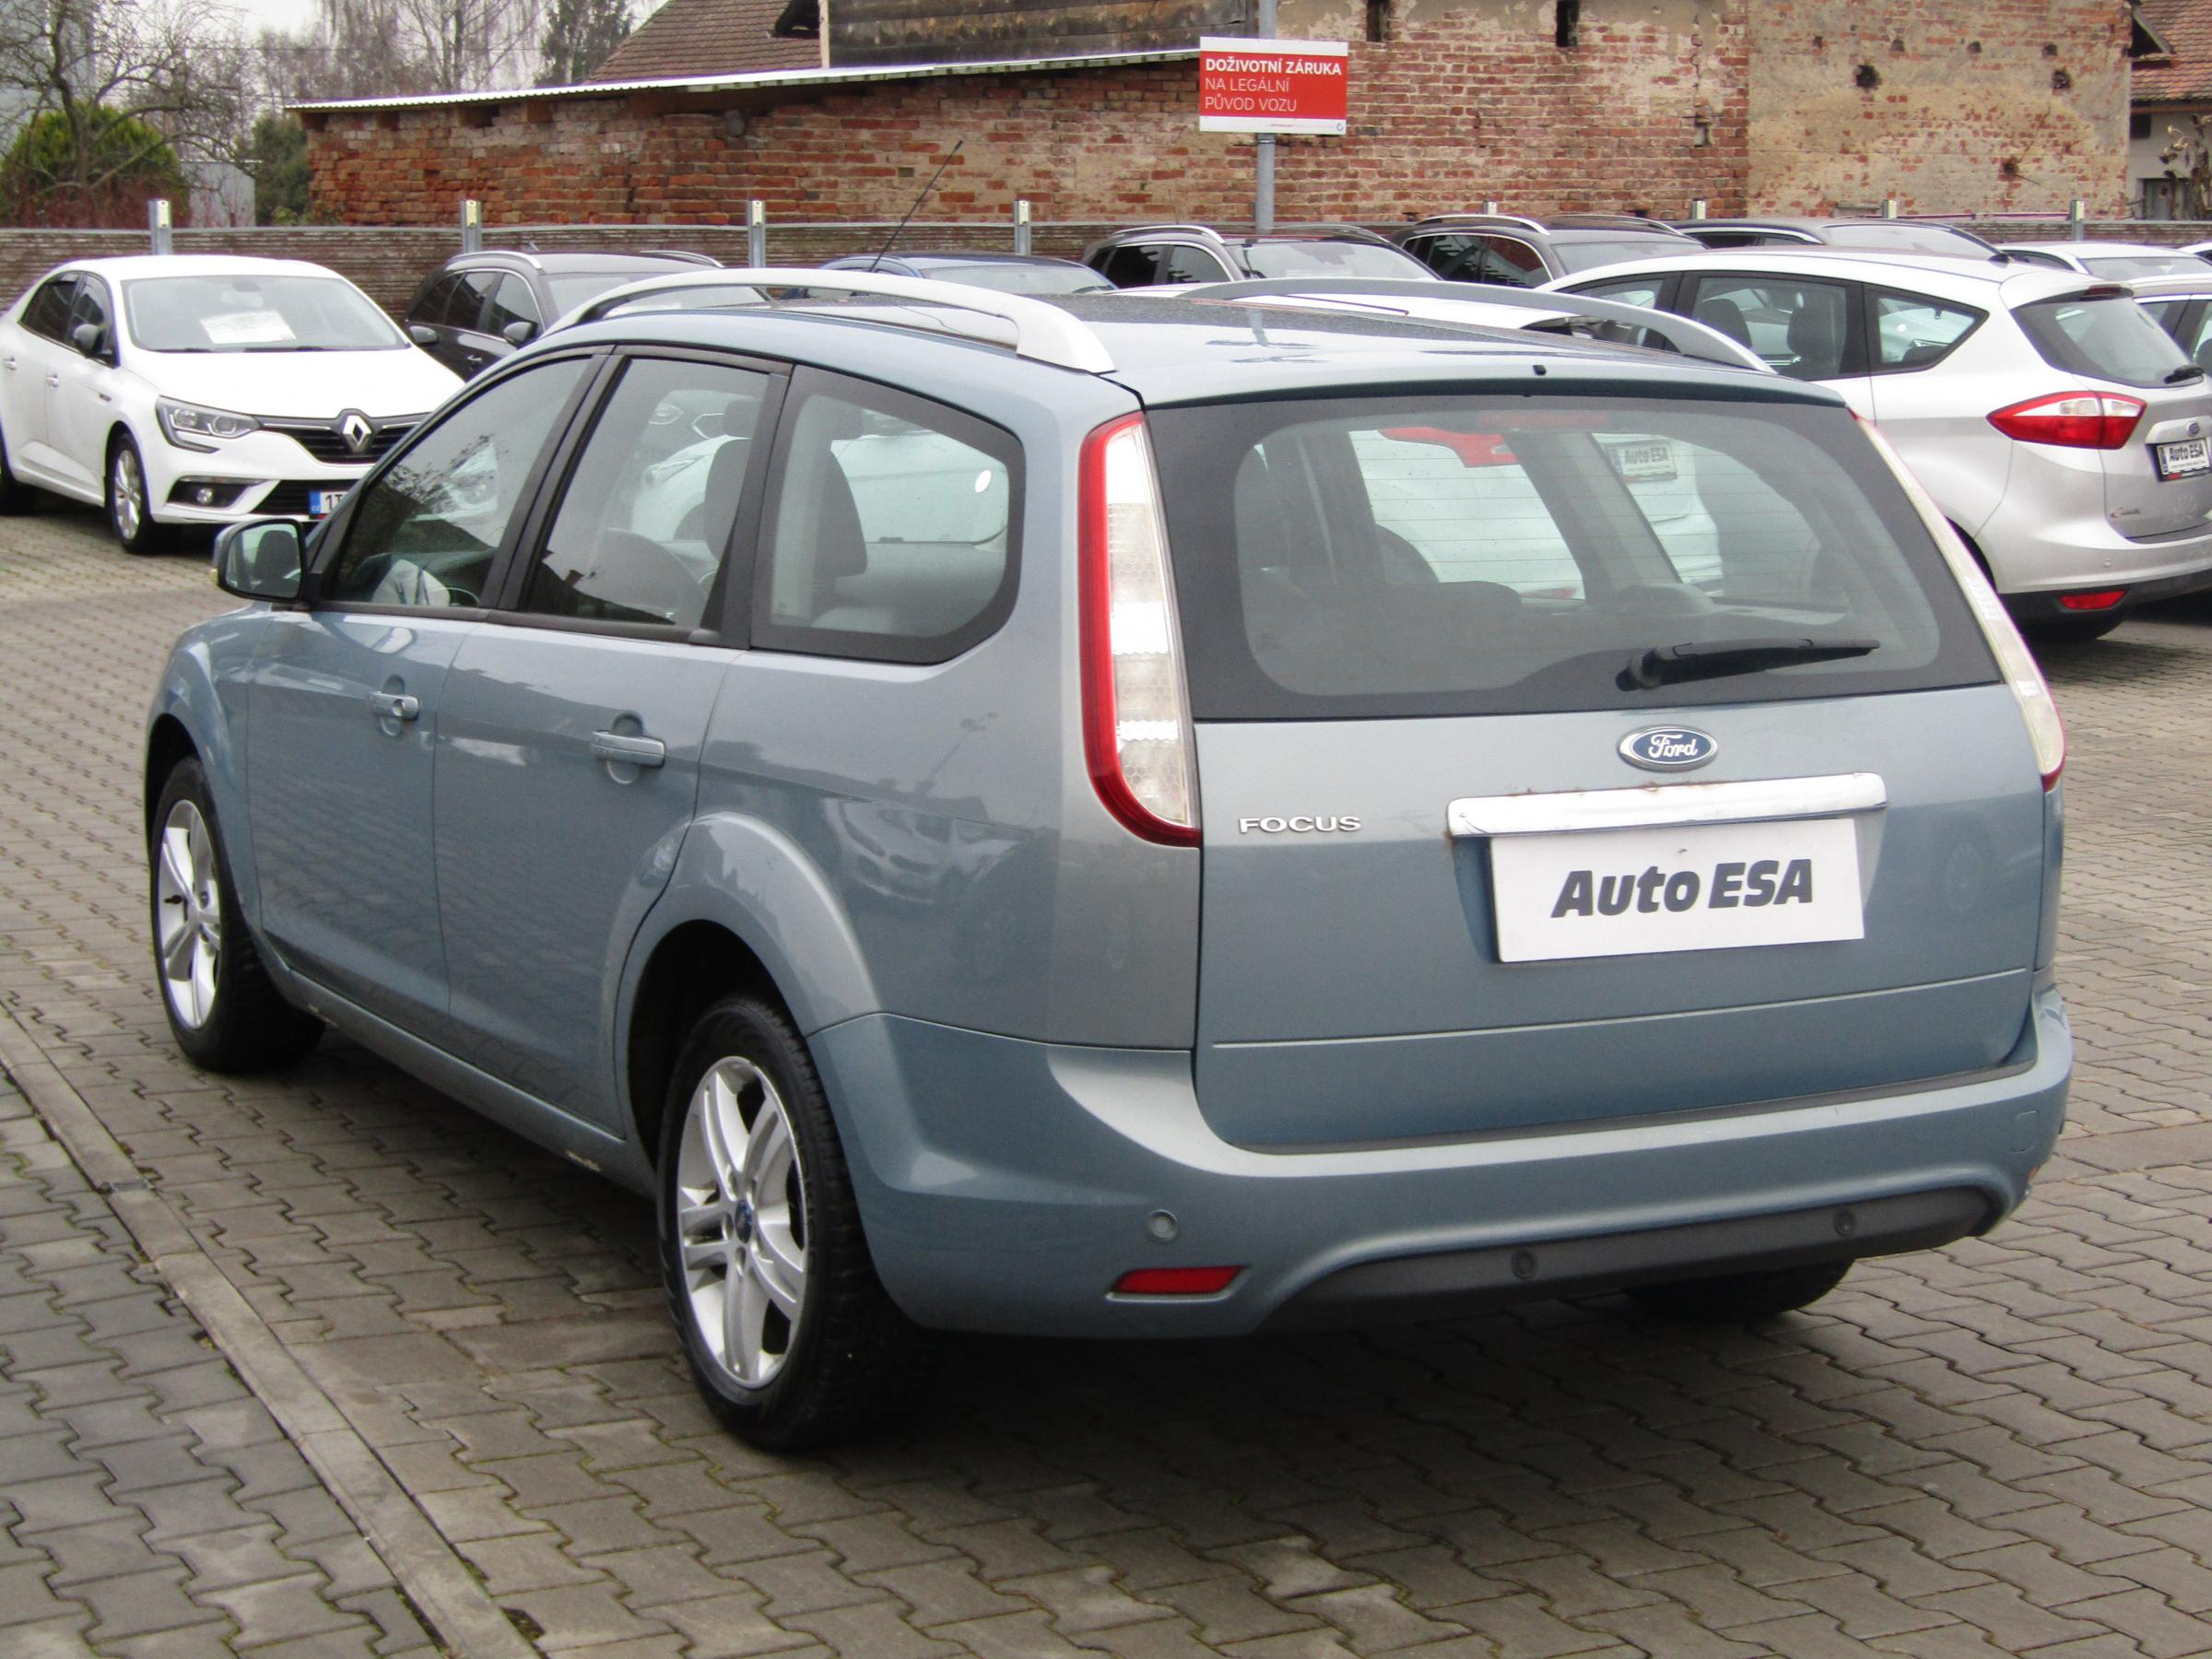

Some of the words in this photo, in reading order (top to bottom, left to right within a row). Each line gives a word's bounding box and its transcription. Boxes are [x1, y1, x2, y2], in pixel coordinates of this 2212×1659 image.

[1206, 56, 1282, 74] DOŽIVOTNÍ
[1286, 59, 1342, 76] ZÁRUKA
[1205, 77, 1226, 90] NA
[1230, 76, 1290, 92] LEGÁLNÍ
[1205, 93, 1254, 111] PŮVOD
[1258, 99, 1298, 112] VOZU
[1624, 449, 1649, 465] Auto
[2169, 446, 2189, 461] Auto
[1648, 734, 1699, 759] Ford
[1239, 816, 1361, 834] FOCUS
[1550, 865, 1700, 918] Auto
[1708, 858, 1813, 909] ESA
